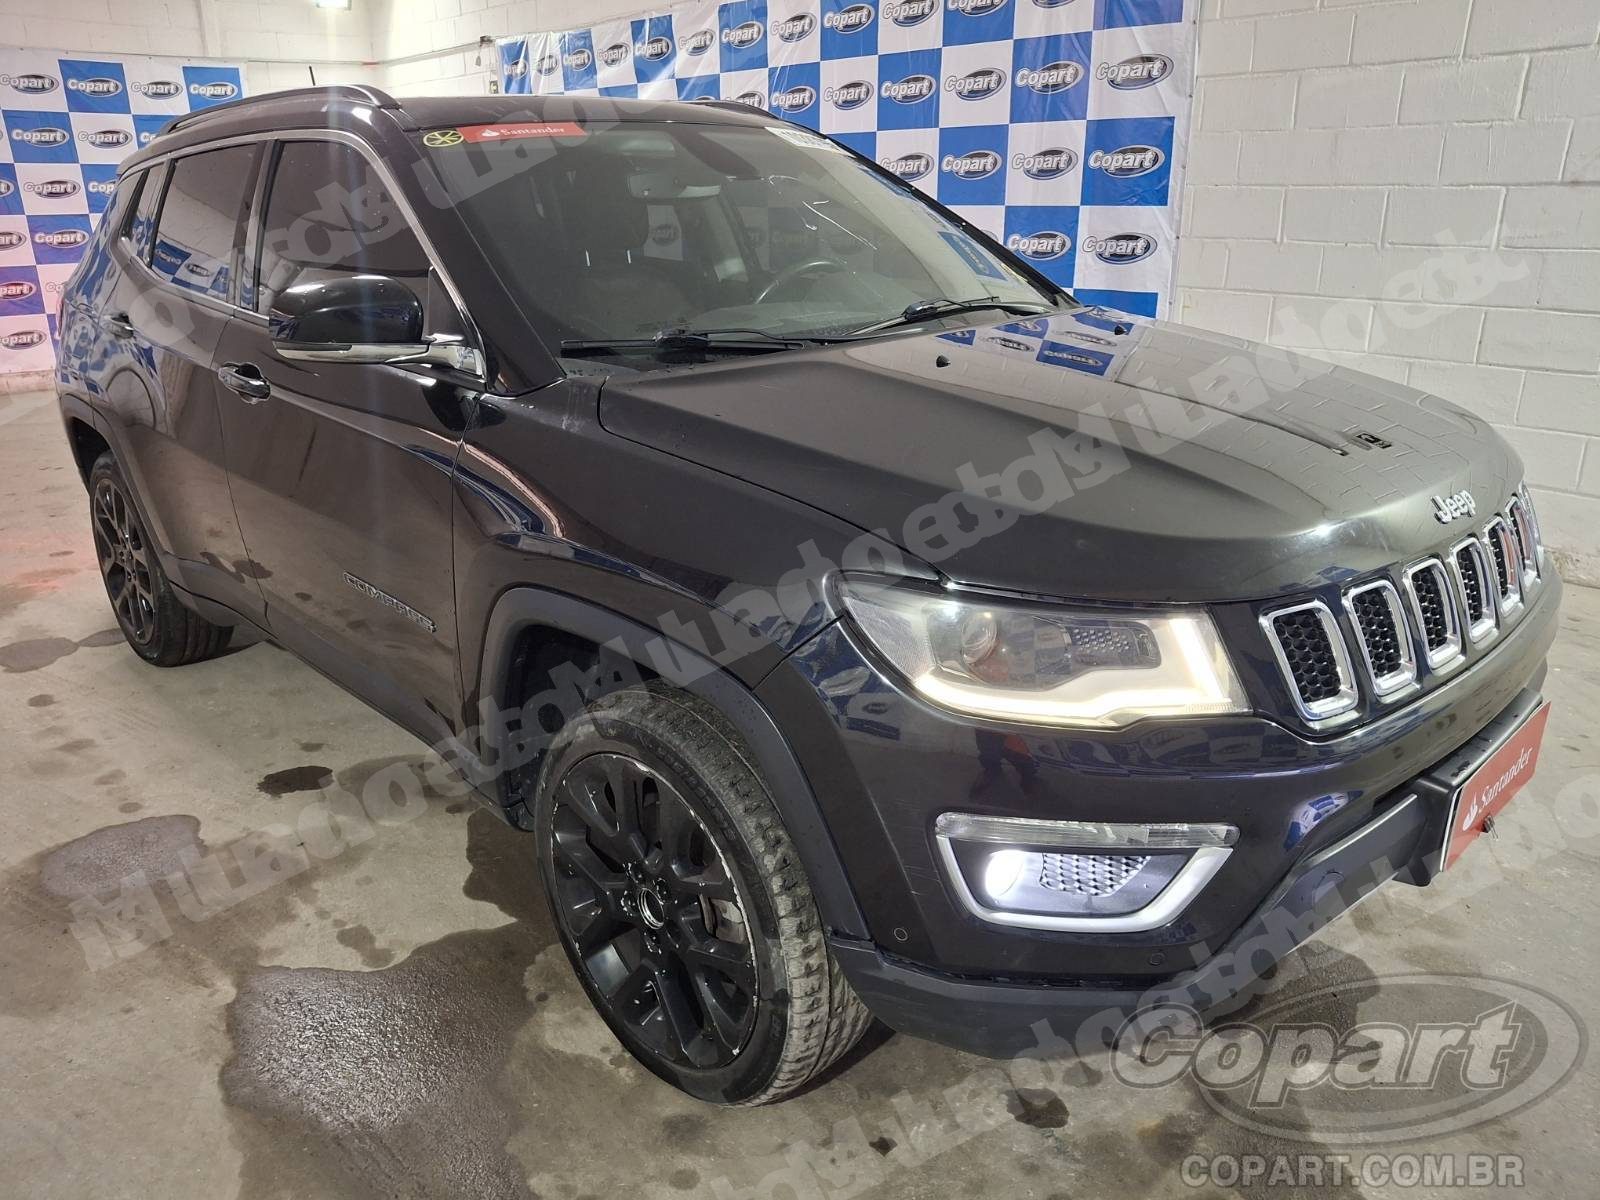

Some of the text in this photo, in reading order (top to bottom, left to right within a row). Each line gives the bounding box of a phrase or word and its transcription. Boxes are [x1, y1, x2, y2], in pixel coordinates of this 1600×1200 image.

[823, 7, 869, 29] Copart
[883, 0, 931, 23] Copart
[721, 25, 759, 44] Copart
[771, 17, 811, 38] Copart
[635, 39, 668, 57] Copart
[680, 30, 712, 51] Copart
[1015, 65, 1076, 90] Copart
[1095, 57, 1164, 85] Copart
[0, 74, 51, 90] Copart
[66, 78, 116, 95] Copart
[131, 80, 176, 98] Copart
[189, 83, 232, 97] Copart
[881, 77, 929, 101] Copart
[944, 72, 1000, 98] Copart
[771, 89, 811, 109] Copart
[823, 84, 867, 105] Copart
[11, 128, 63, 145] Copart
[78, 131, 126, 146] Copart
[500, 125, 565, 136] Santander
[942, 151, 994, 175] Copart
[1012, 150, 1068, 176] Copart
[1089, 146, 1159, 174] Copart
[23, 180, 73, 196] Copart
[34, 232, 83, 248] Copart
[1007, 233, 1064, 258] Copart
[1082, 233, 1150, 258] Copart
[1433, 490, 1476, 523] Jeep
[1479, 746, 1534, 814] Santander
